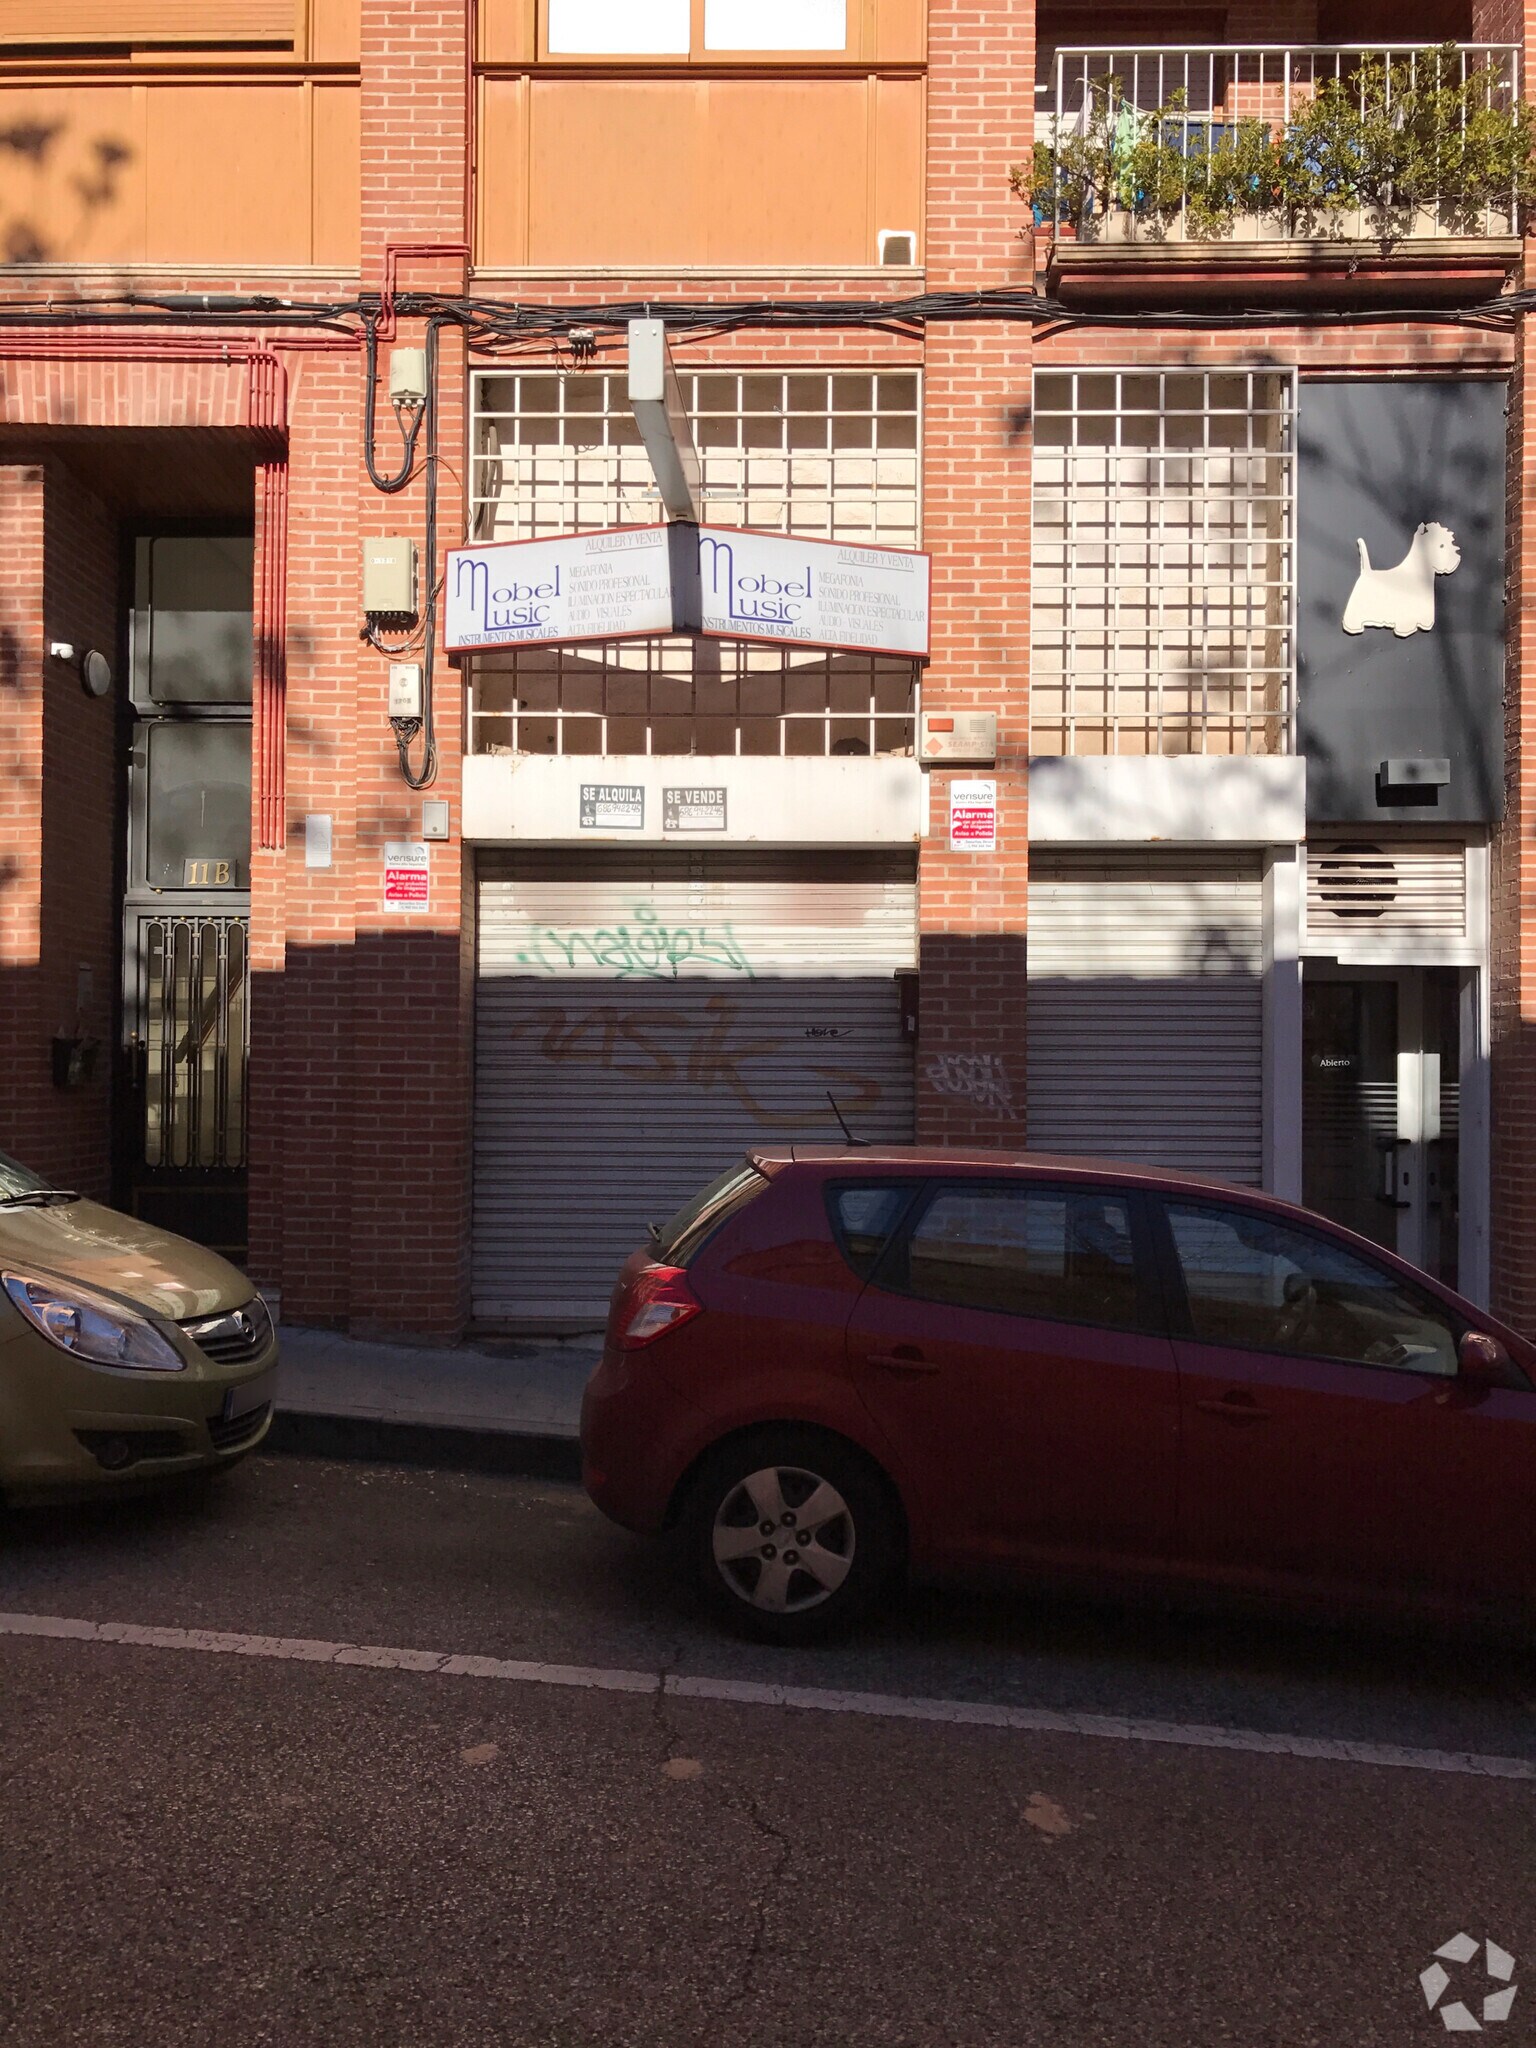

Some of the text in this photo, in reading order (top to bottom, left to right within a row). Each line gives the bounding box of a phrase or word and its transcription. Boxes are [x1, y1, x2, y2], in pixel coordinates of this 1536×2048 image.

[585, 531, 663, 552] ALQUILER Y VENTA
[837, 549, 914, 569] ALQUILER Y VENTA
[569, 574, 651, 594] SONIDO PROFESIONAL
[818, 571, 864, 588] MEGAFONIA
[818, 586, 901, 606] SONIDO PROFESIONAL
[866, 605, 925, 622] ESPECTACULAR
[458, 626, 559, 646] INSTRUMENTOS MUSICALES
[765, 623, 812, 639] MUSICALES
[583, 787, 642, 802] SE ALQUILA
[667, 790, 724, 804] SE VENDE
[953, 810, 993, 819] Alarma
[387, 871, 427, 880] Alarma
[1319, 1059, 1350, 1067] Abierto
